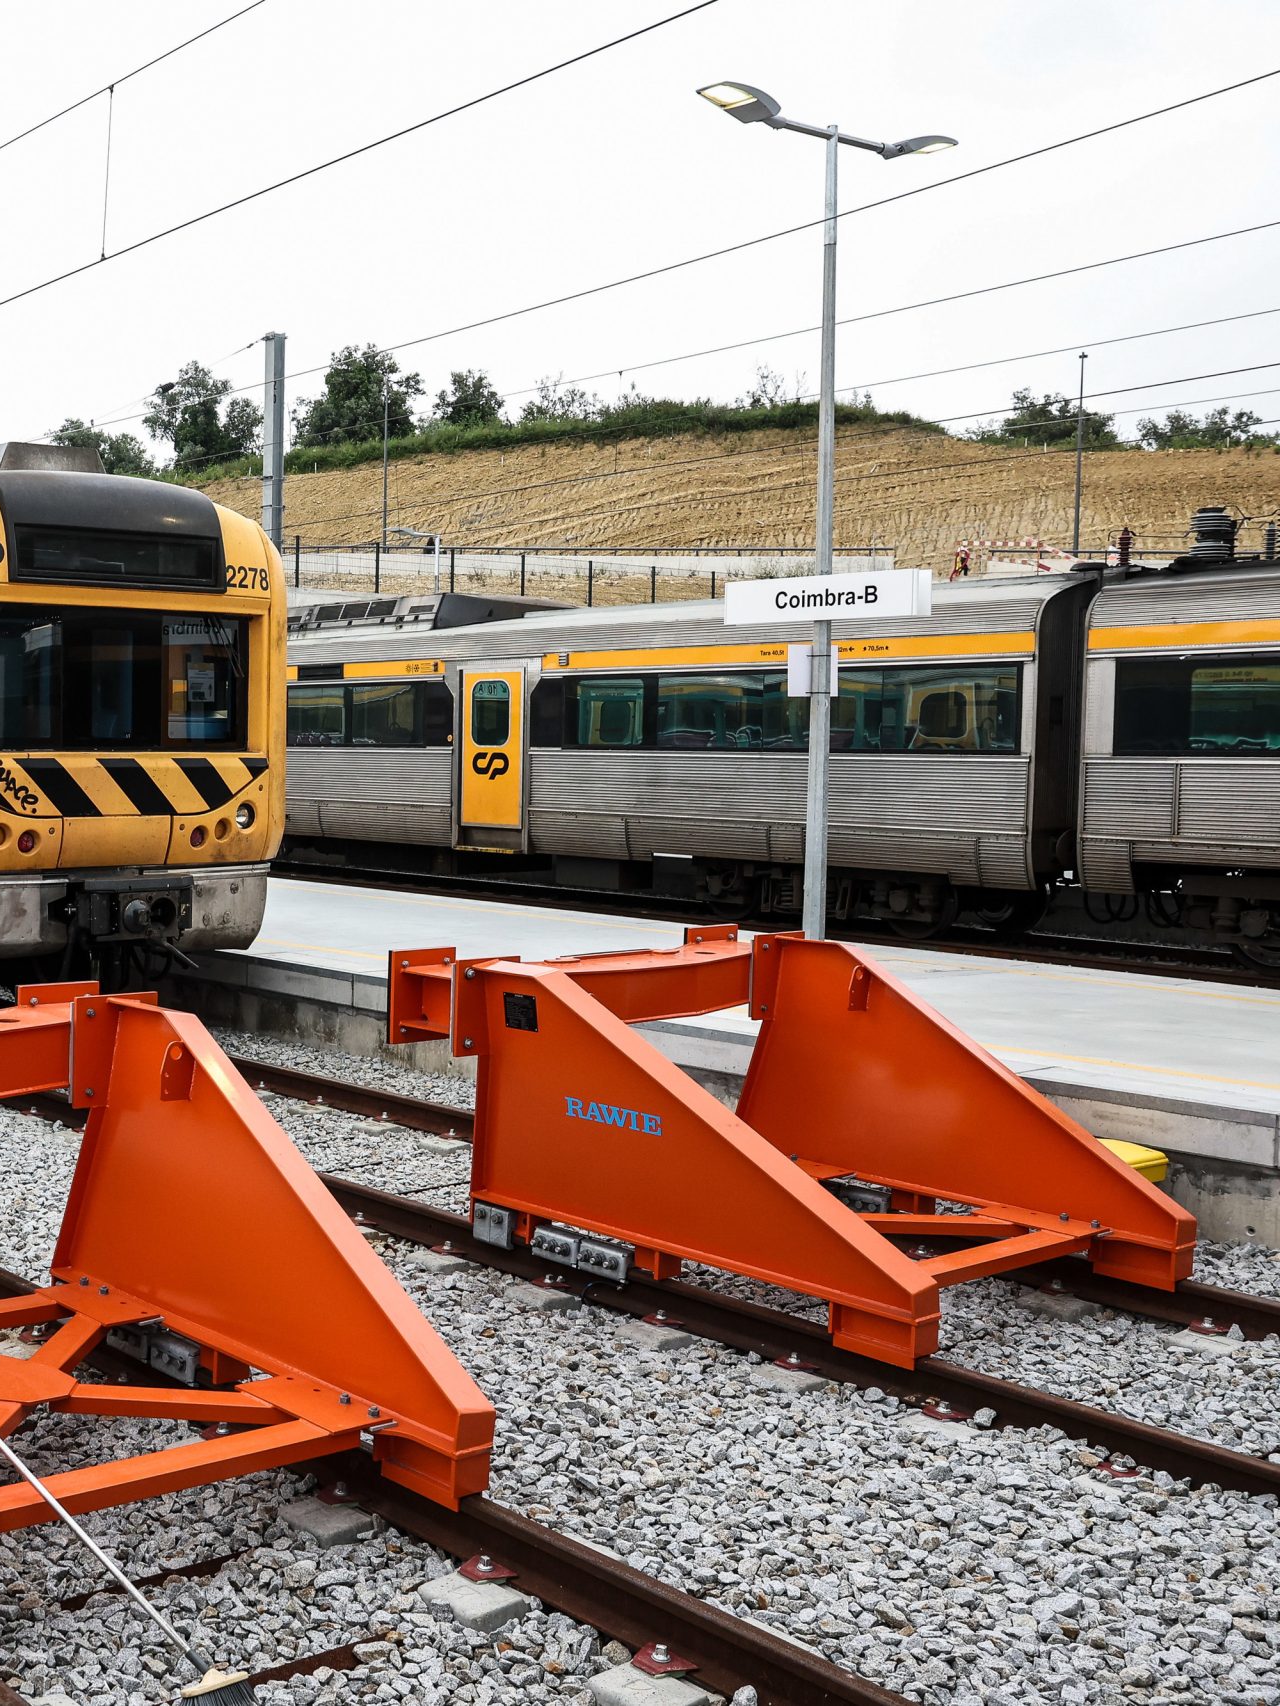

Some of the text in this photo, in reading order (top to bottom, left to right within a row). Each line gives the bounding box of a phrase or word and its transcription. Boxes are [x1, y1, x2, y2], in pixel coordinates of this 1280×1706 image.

[226, 564, 269, 591] 2278
[775, 585, 878, 609] Coimbra-B
[472, 752, 509, 780] CP
[565, 1096, 662, 1136] RAWIE
